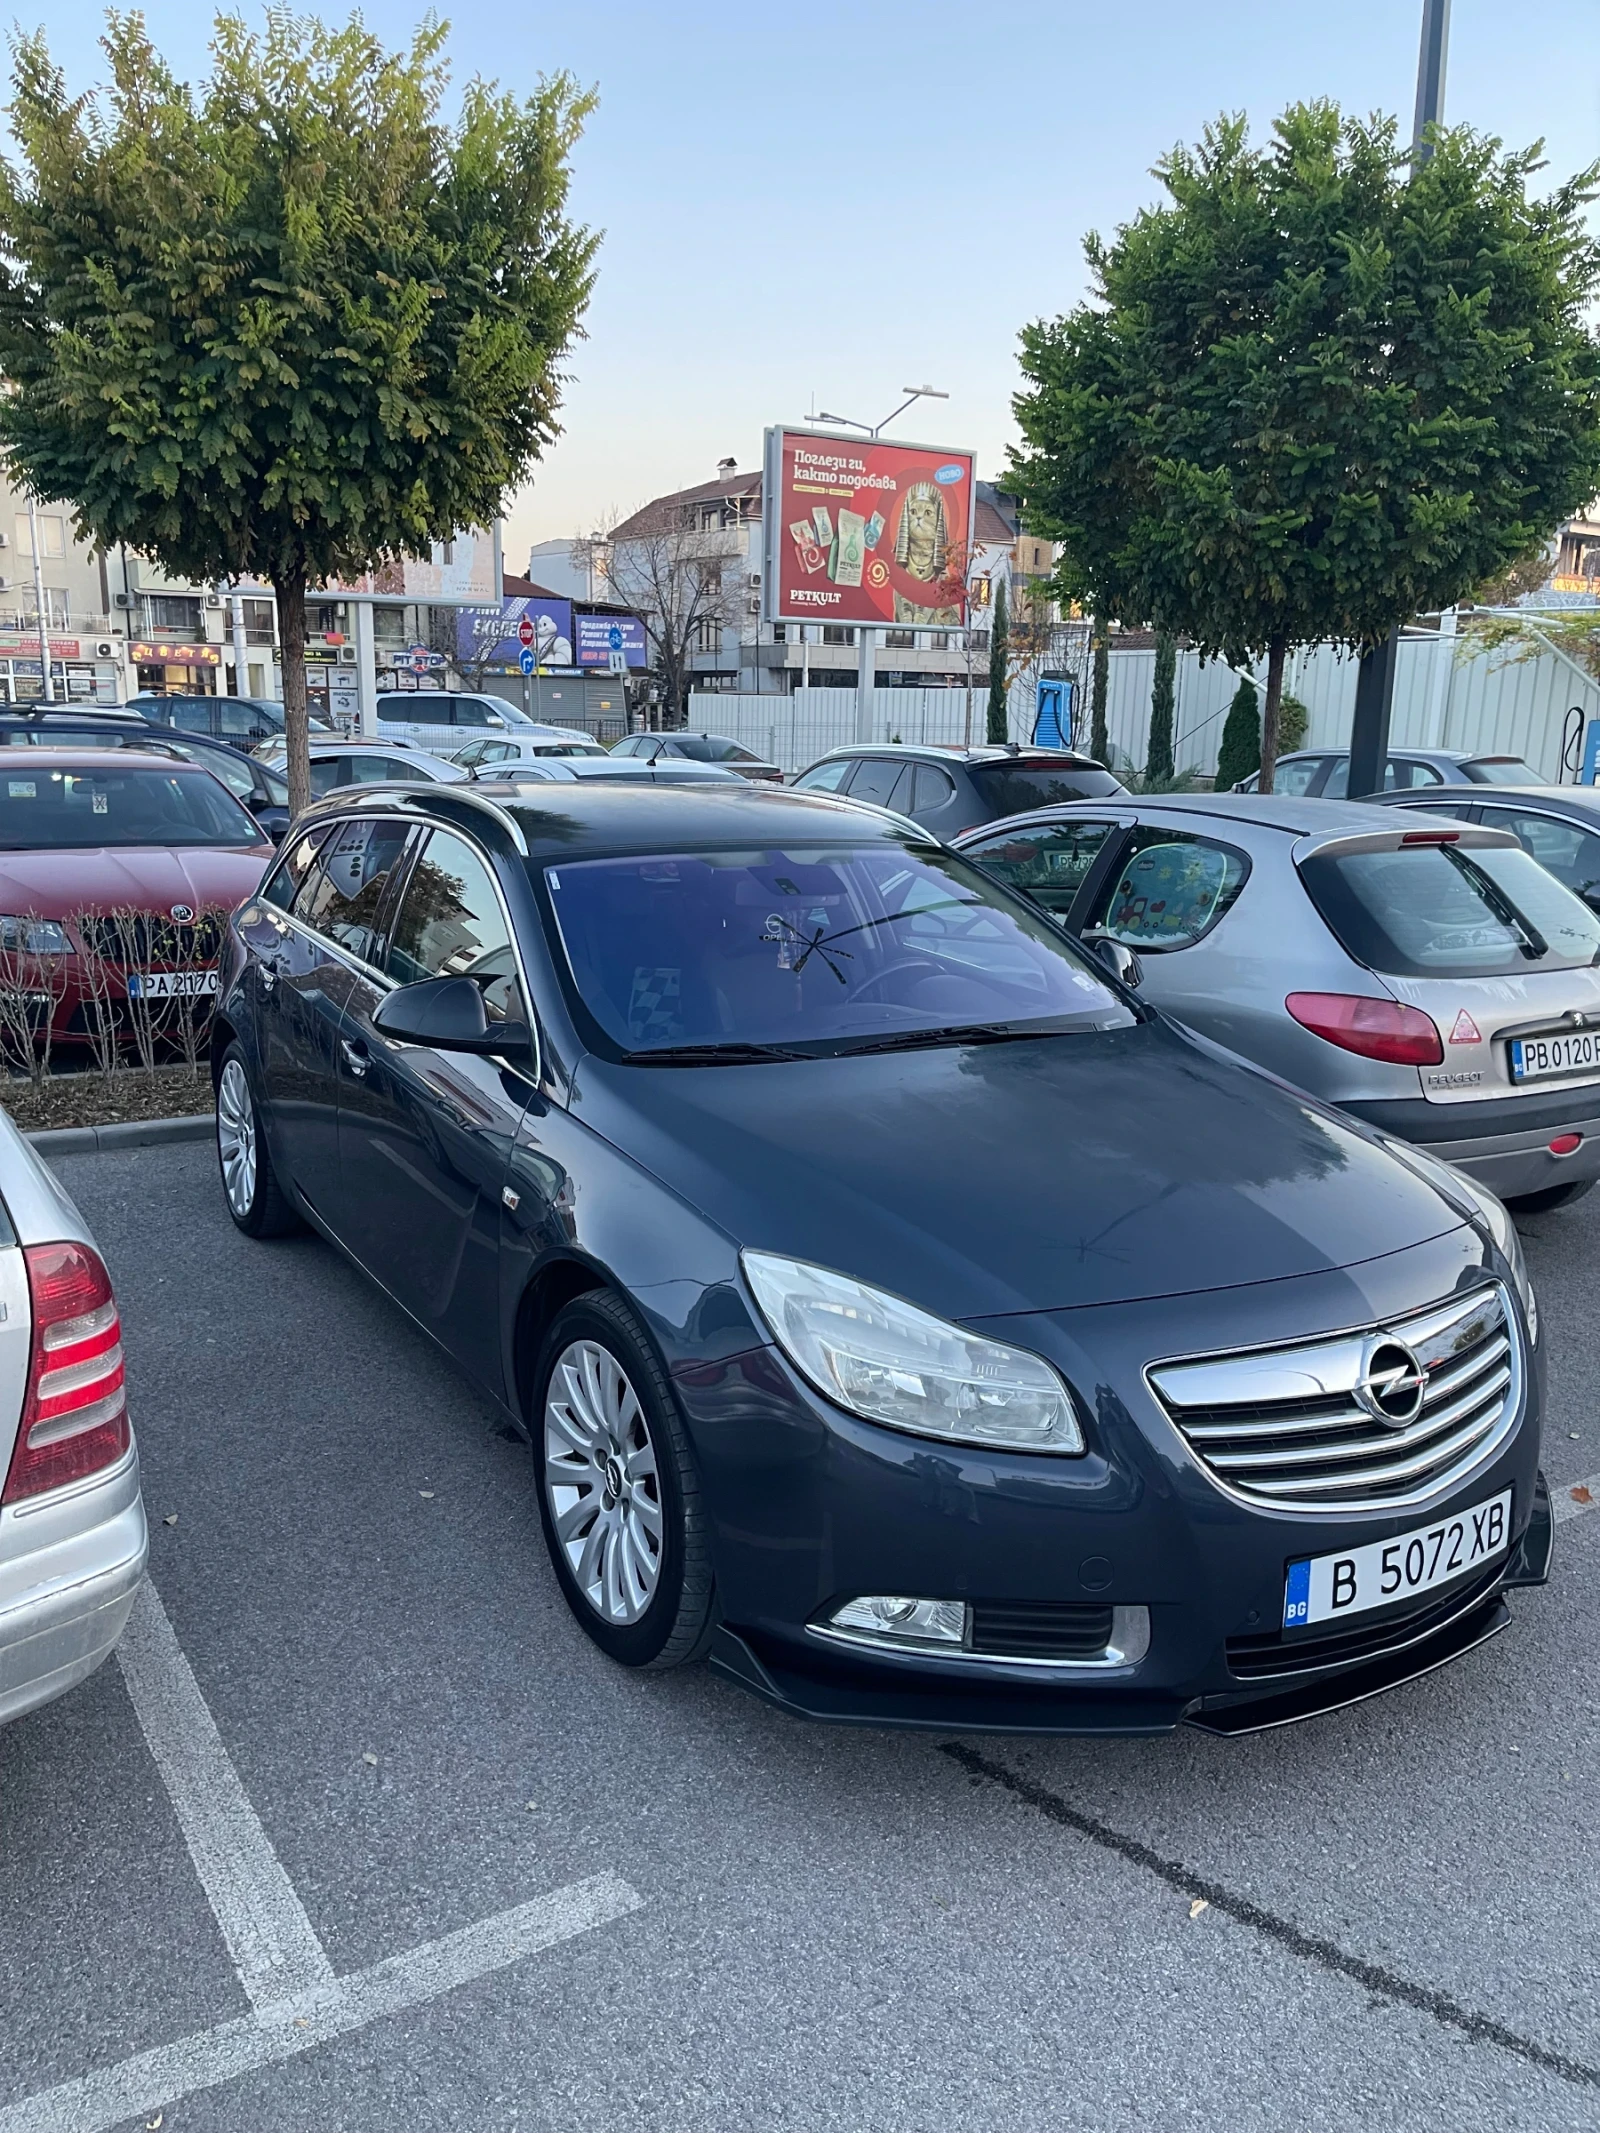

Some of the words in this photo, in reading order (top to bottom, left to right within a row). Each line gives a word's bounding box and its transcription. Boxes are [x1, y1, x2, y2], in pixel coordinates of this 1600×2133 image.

[794, 450, 847, 471] Поглези
[848, 462, 866, 473] ги,
[793, 465, 837, 485] както
[839, 474, 897, 491] подобава
[790, 589, 842, 606] PETKULT
[581, 621, 610, 630] Продажба
[520, 628, 533, 638] STOP
[581, 630, 603, 638] Ремонт
[144, 646, 210, 658] ЦВЕТЯ
[393, 655, 411, 665] PIT
[415, 655, 446, 666] STOP
[1525, 1043, 1549, 1071] PB
[1552, 1035, 1592, 1067] 0120
[1514, 1063, 1523, 1072] BG
[1428, 1071, 1485, 1085] PEUGEOT
[1332, 1559, 1357, 1609] B
[1380, 1522, 1464, 1594] 5072
[1469, 1501, 1504, 1561] XB
[1287, 1601, 1307, 1619] BG
